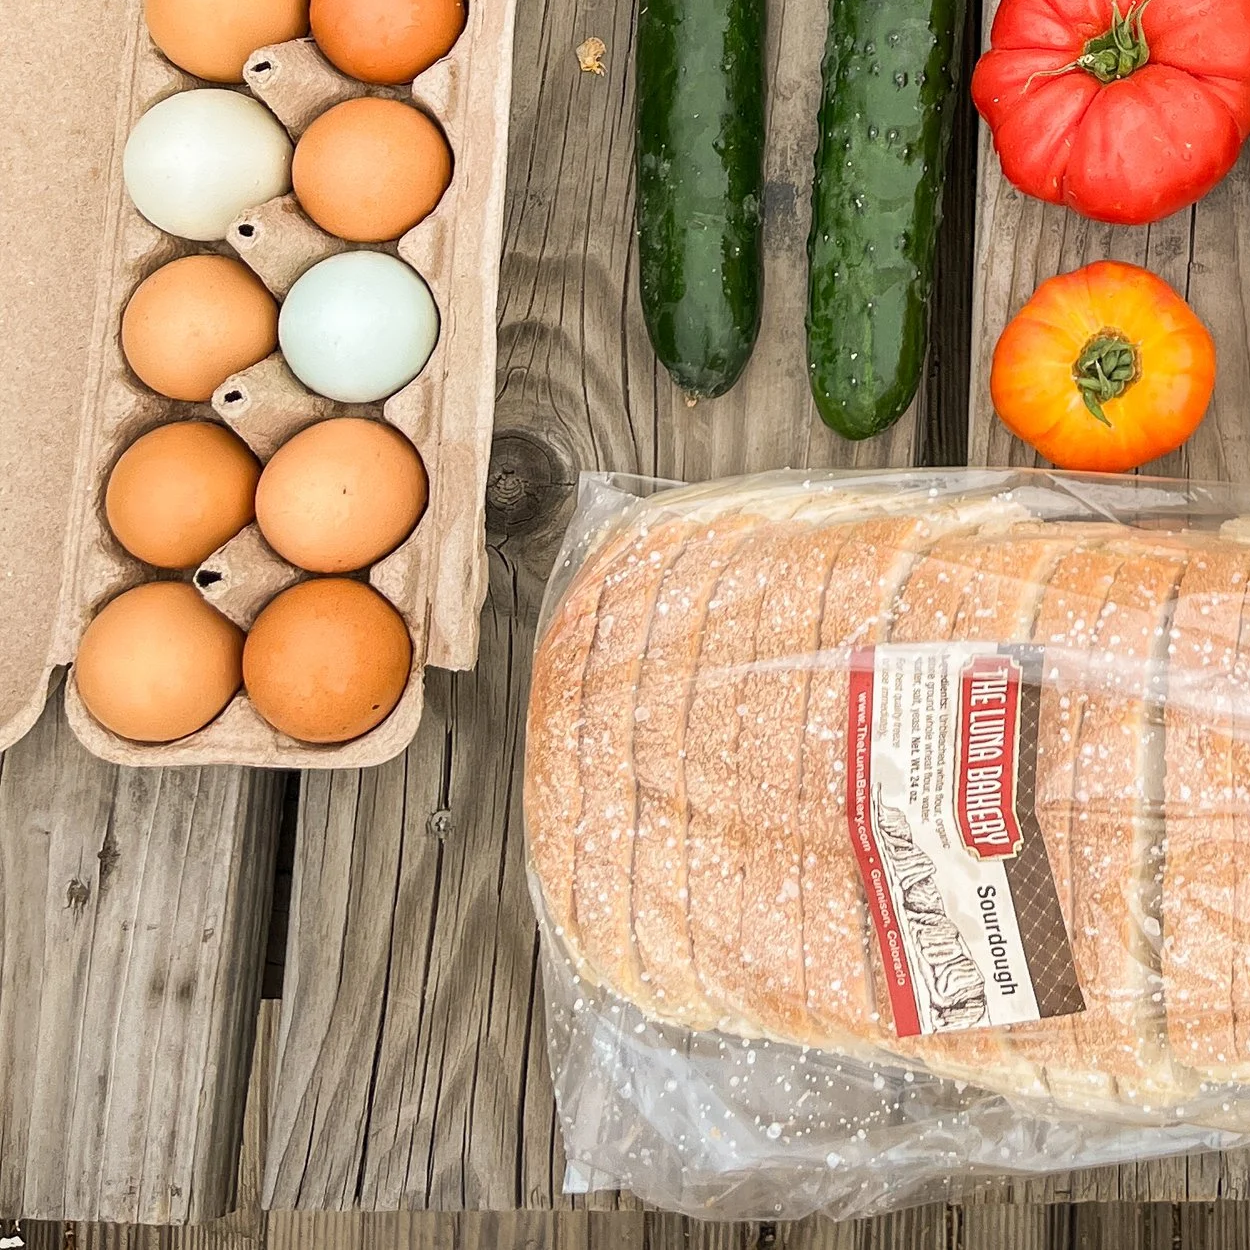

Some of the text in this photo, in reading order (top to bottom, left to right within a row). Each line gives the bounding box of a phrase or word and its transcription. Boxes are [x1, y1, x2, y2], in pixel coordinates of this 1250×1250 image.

[894, 671, 904, 692] best
[925, 681, 935, 712] ground
[891, 693, 902, 720] quality
[892, 720, 902, 750] freeze
[925, 713, 935, 740] whole
[937, 713, 949, 767] Unbleached
[924, 742, 934, 771] wheat
[966, 666, 1011, 845] THE LUNA BAKERY
[909, 775, 920, 788] 24
[934, 768, 944, 792] white
[854, 691, 907, 986] www.TheLunaBakery.com Gunnison, Colorado
[935, 817, 950, 850] organic
[976, 885, 1019, 995] Sourdough
